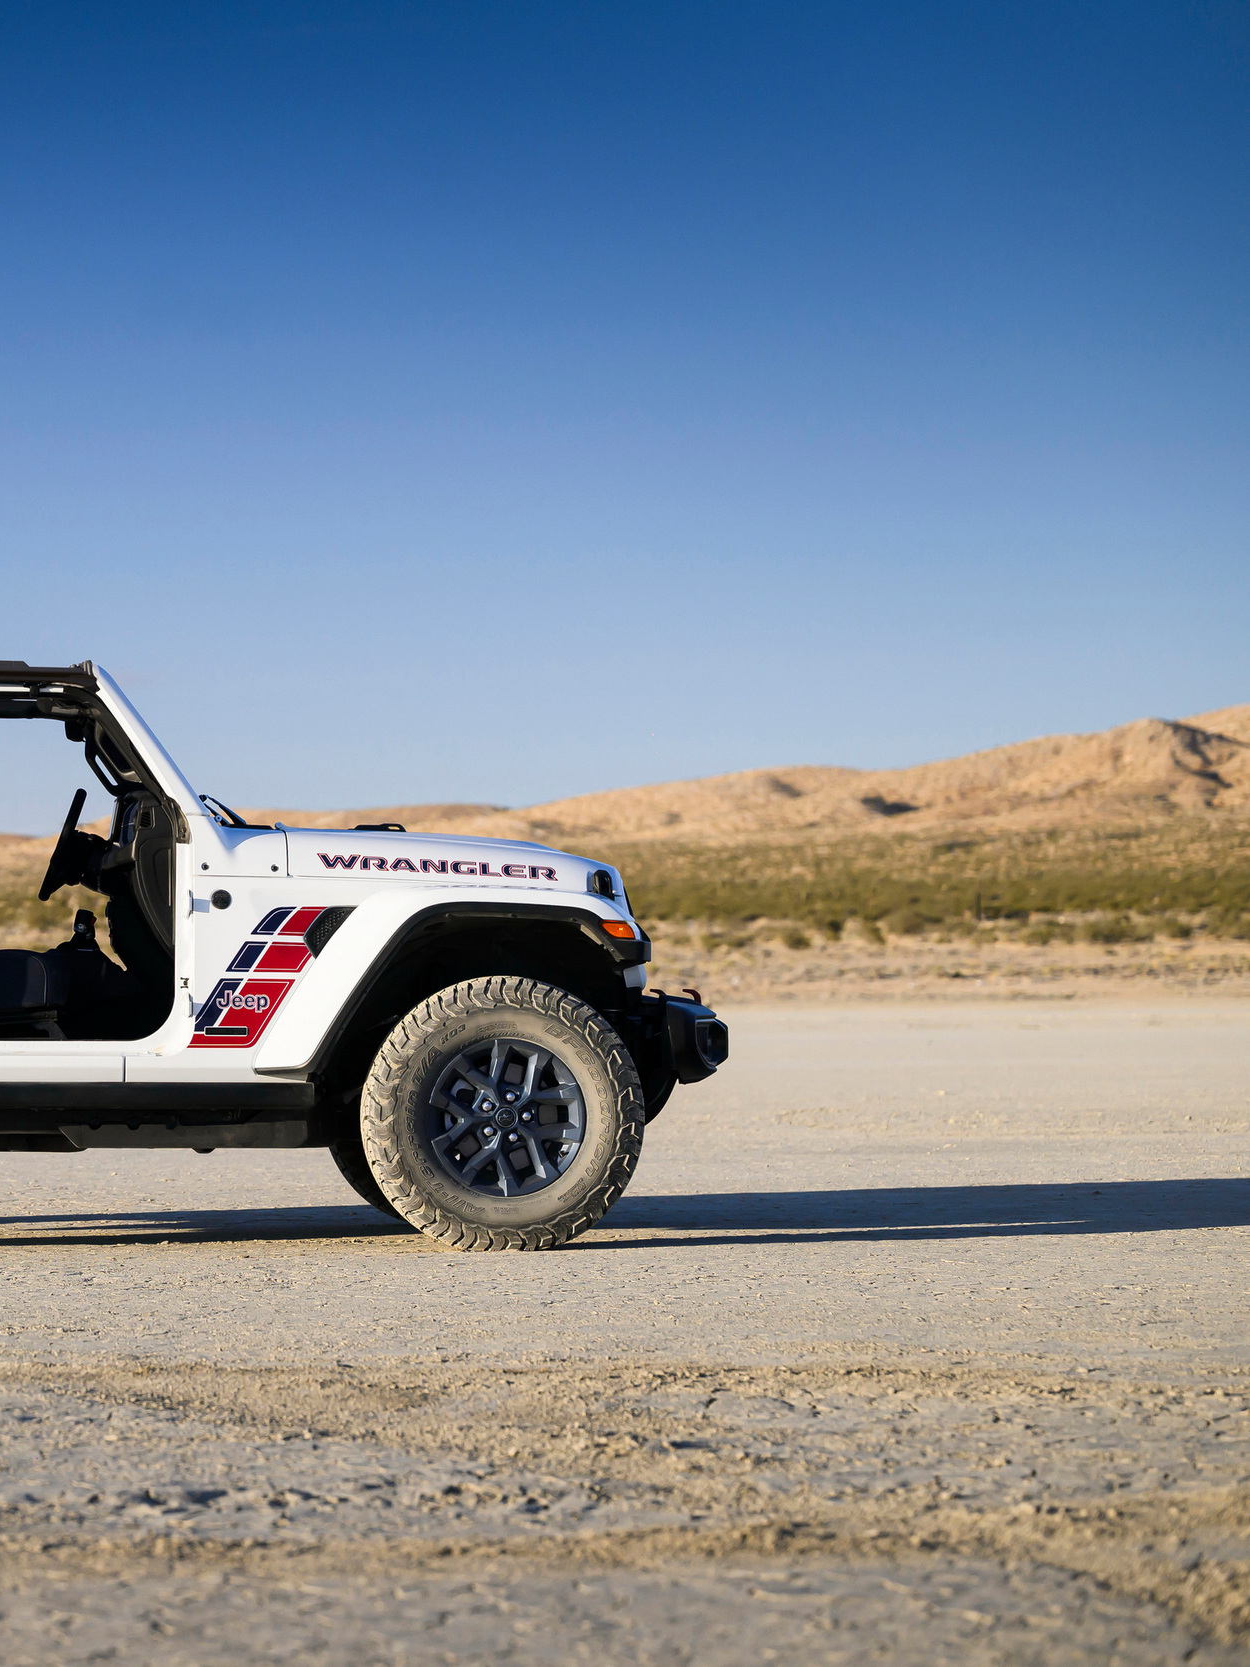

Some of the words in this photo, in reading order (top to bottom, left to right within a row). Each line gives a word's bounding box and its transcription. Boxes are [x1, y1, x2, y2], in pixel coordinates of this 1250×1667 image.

[317, 853, 558, 881] WRANGLER
[216, 990, 270, 1013] Jeep
[411, 1045, 443, 1085] T/A
[544, 1023, 615, 1177] BFGoodrich
[405, 1089, 485, 1215] All-Terrain
